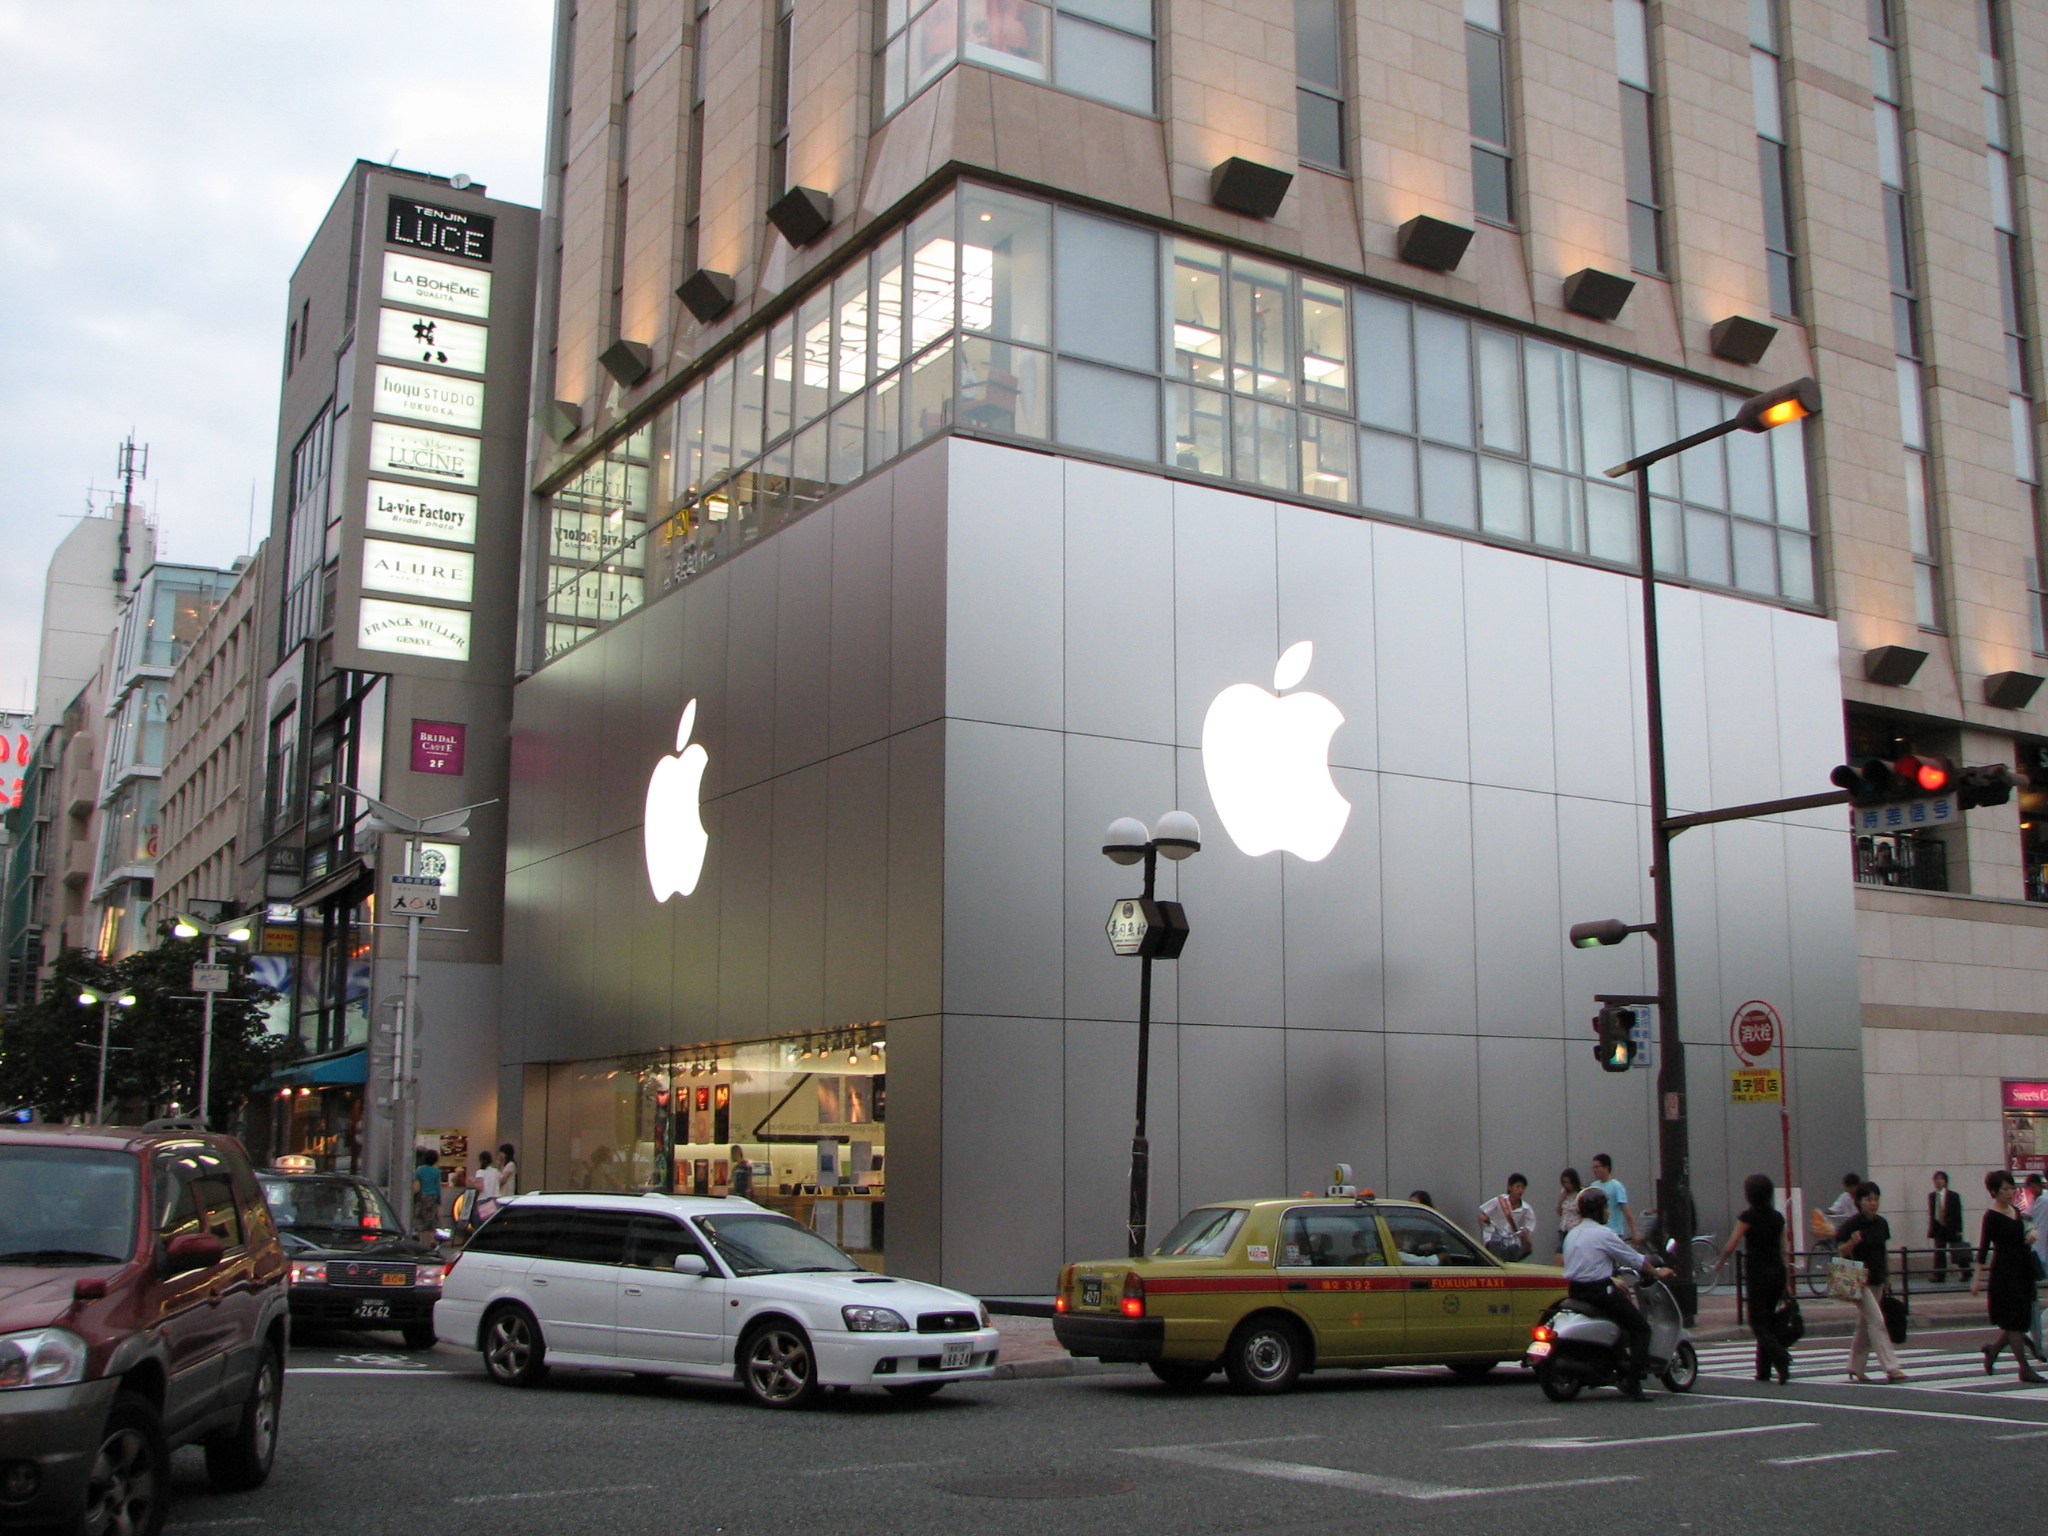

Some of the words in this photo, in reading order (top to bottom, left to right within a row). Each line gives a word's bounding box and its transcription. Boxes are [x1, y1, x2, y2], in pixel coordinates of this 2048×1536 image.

[414, 205, 467, 224] TENJIN
[394, 215, 484, 258] LUCE
[383, 377, 420, 398] hoyu
[424, 388, 475, 407] STUDIO
[403, 400, 454, 416] FUKUOKA
[389, 446, 465, 472] LUCINE
[378, 496, 416, 516] La-vie
[419, 503, 465, 527] Factory
[392, 515, 422, 525] Bridal
[425, 521, 455, 530] photo
[374, 559, 463, 581] ALURE
[364, 617, 414, 636] FRANCK
[418, 618, 466, 649] MULLER
[396, 635, 433, 647] GENEVE
[420, 732, 457, 744] BRIDAL
[1741, 1023, 1772, 1043] 消火栓
[2013, 1089, 2039, 1102] Sweets
[1345, 1280, 1371, 1290] 392
[1431, 1279, 1478, 1289] FUKUUN
[1480, 1278, 1505, 1288] TAXI
[360, 1305, 390, 1318] 26-62
